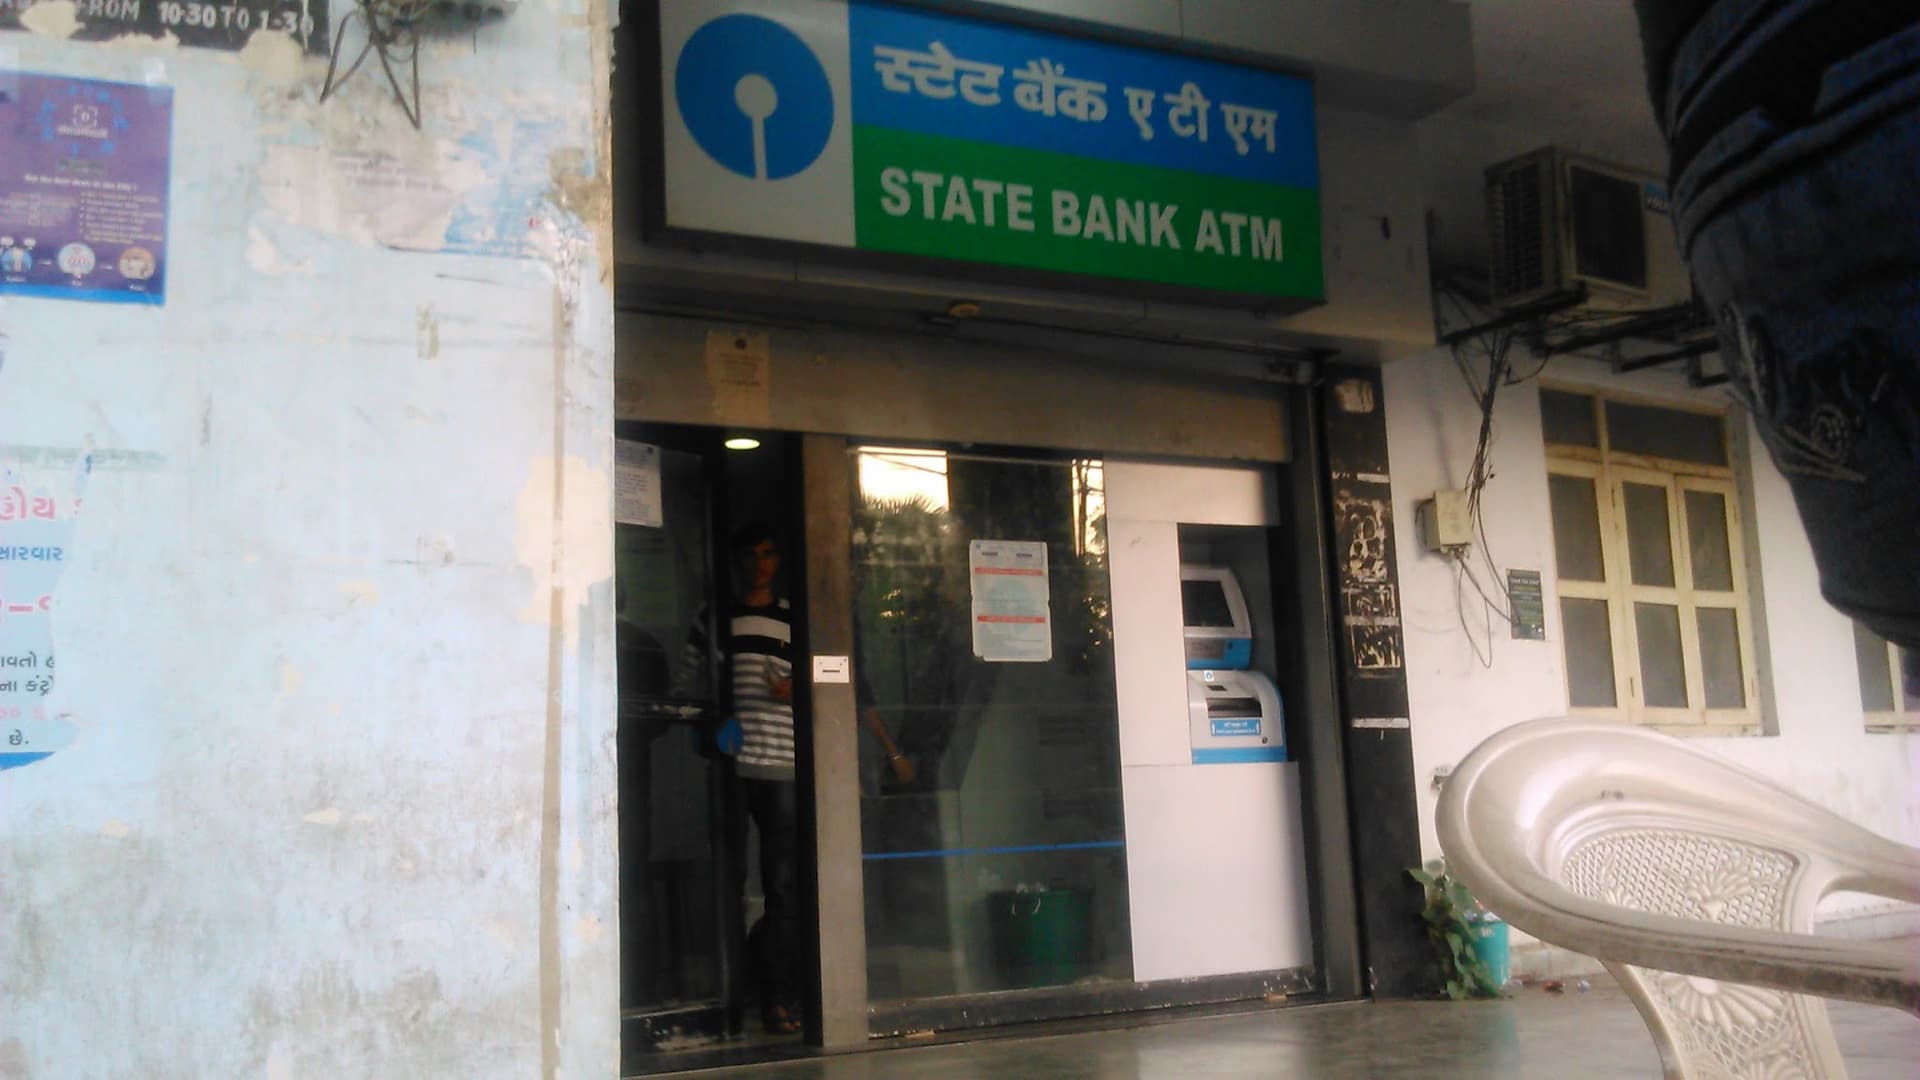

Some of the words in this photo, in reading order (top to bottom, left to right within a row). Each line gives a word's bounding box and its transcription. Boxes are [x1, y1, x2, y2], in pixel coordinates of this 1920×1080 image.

[220, 5, 250, 32] TO
[874, 41, 1005, 107] स्टेट
[1012, 56, 1109, 122] बैंक
[1123, 86, 1156, 141] ए
[1163, 81, 1211, 142] टी
[1219, 102, 1279, 156] एम
[879, 166, 1036, 233] STATE
[1050, 188, 1182, 250] BANK
[1194, 209, 1284, 263] ATM
